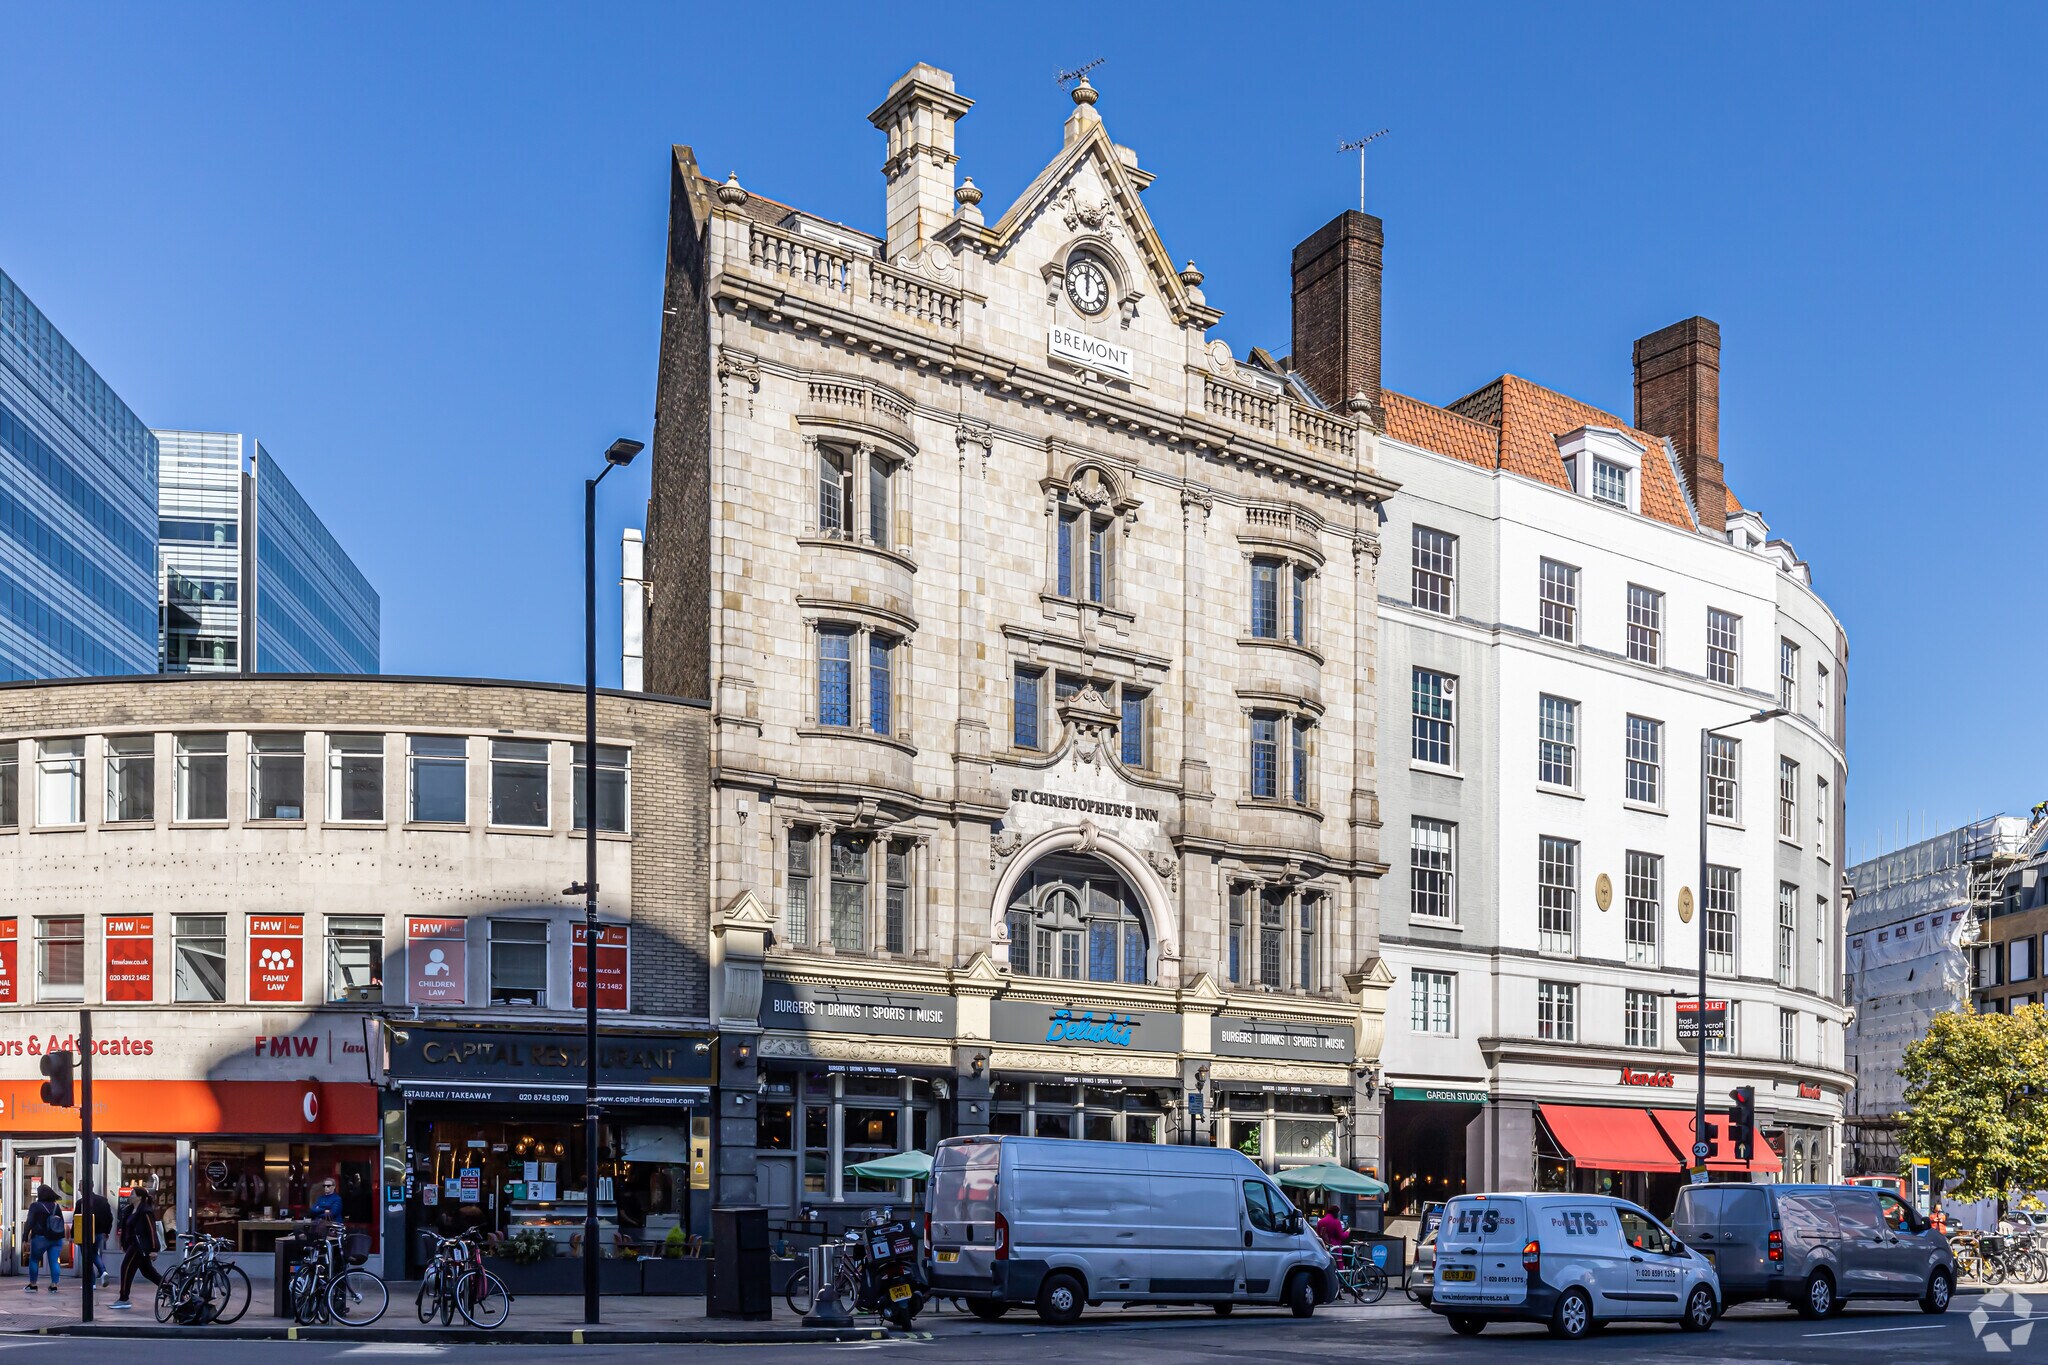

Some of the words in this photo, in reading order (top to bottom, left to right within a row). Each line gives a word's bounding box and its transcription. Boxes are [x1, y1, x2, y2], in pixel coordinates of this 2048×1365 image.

[1054, 329, 1128, 365] BREMONT
[1011, 788, 1028, 802] ST
[1030, 791, 1133, 819] CHRISTOPHER'S
[1135, 807, 1159, 822] INN
[109, 921, 134, 932] FMW
[253, 921, 282, 931] FMW
[412, 923, 442, 934] FMW
[111, 958, 149, 966] fmwlaw.co.uk
[262, 974, 290, 982] FAMILY
[267, 983, 285, 991] LAW
[418, 980, 456, 988] CHILDREN
[607, 982, 623, 990] 1482
[1711, 1001, 1723, 1009] LET
[774, 999, 816, 1015] BURGERS
[828, 1004, 861, 1018] DRINKS
[872, 1006, 905, 1021] SPORTS
[916, 1009, 943, 1023] MUSIC
[1678, 1017, 1693, 1025] frost
[1046, 1009, 1133, 1047] Belushi's
[1709, 1029, 1725, 1037] 1200
[27, 1034, 42, 1056] &
[1221, 1030, 1252, 1044] BURGERS
[1260, 1033, 1285, 1046] DRINKS
[1293, 1036, 1317, 1048] SPORTS
[1325, 1038, 1345, 1050] MUSIC
[255, 1036, 319, 1057] FMW
[423, 1040, 524, 1067] CAPITAL
[1621, 1067, 1675, 1088] Nando's
[404, 1090, 445, 1098] ESTAURANT
[451, 1091, 491, 1099] TAKEAWAY
[1426, 1090, 1456, 1100] GARDEN
[1457, 1092, 1487, 1102] STUDIOS
[1798, 1081, 1822, 1101] Nando's
[519, 1093, 532, 1101] 020
[551, 1094, 569, 1102] 0590
[1694, 1145, 1708, 1154] 20
[462, 1169, 479, 1177] OPEN
[1458, 1208, 1500, 1234] LTS
[1561, 1211, 1598, 1236] LTS
[877, 1246, 886, 1254] L
[1642, 1269, 1651, 1277] 020
[1664, 1270, 1675, 1278] 1375
